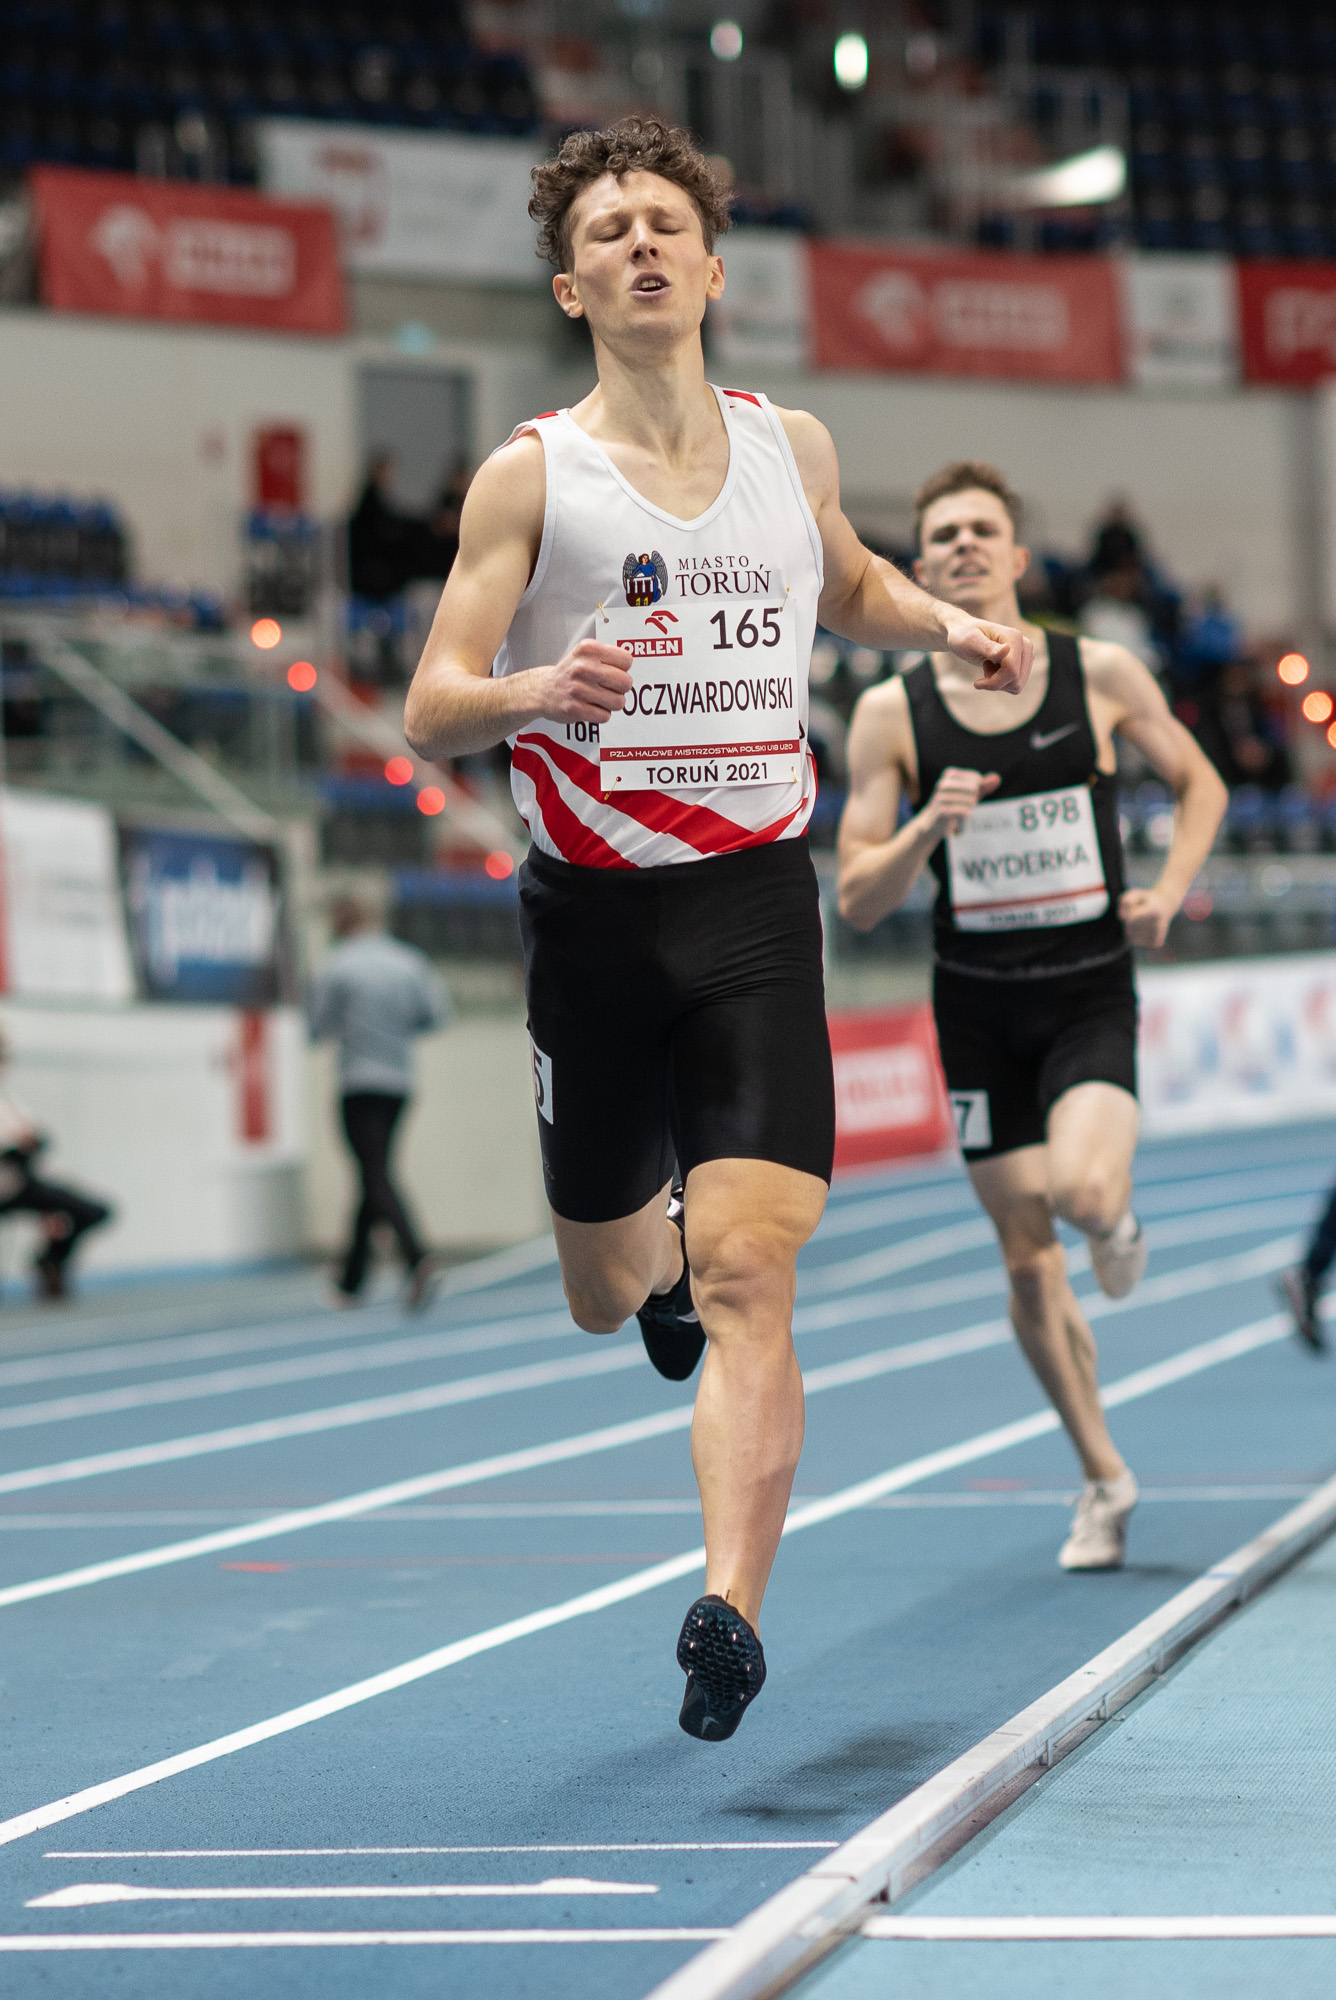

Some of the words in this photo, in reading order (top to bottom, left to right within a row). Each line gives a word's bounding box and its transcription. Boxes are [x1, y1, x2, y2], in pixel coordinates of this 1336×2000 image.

[678, 555, 750, 571] MIASTO
[675, 564, 772, 597] TORUŃ
[709, 607, 781, 650] 165
[620, 639, 680, 655] ORLEN
[621, 677, 793, 716] OCZWARDOWSKI
[609, 750, 634, 758] PZLA
[635, 748, 673, 757] HALOWE
[674, 746, 739, 757] MISTRZOSTWA
[739, 745, 767, 753] POLSKI
[780, 743, 793, 751] U20
[646, 760, 719, 785] TORUŃ
[726, 762, 768, 782] 2021
[1019, 796, 1080, 832] 898
[961, 844, 1090, 882] WYDERKA
[955, 1100, 974, 1140] 7
